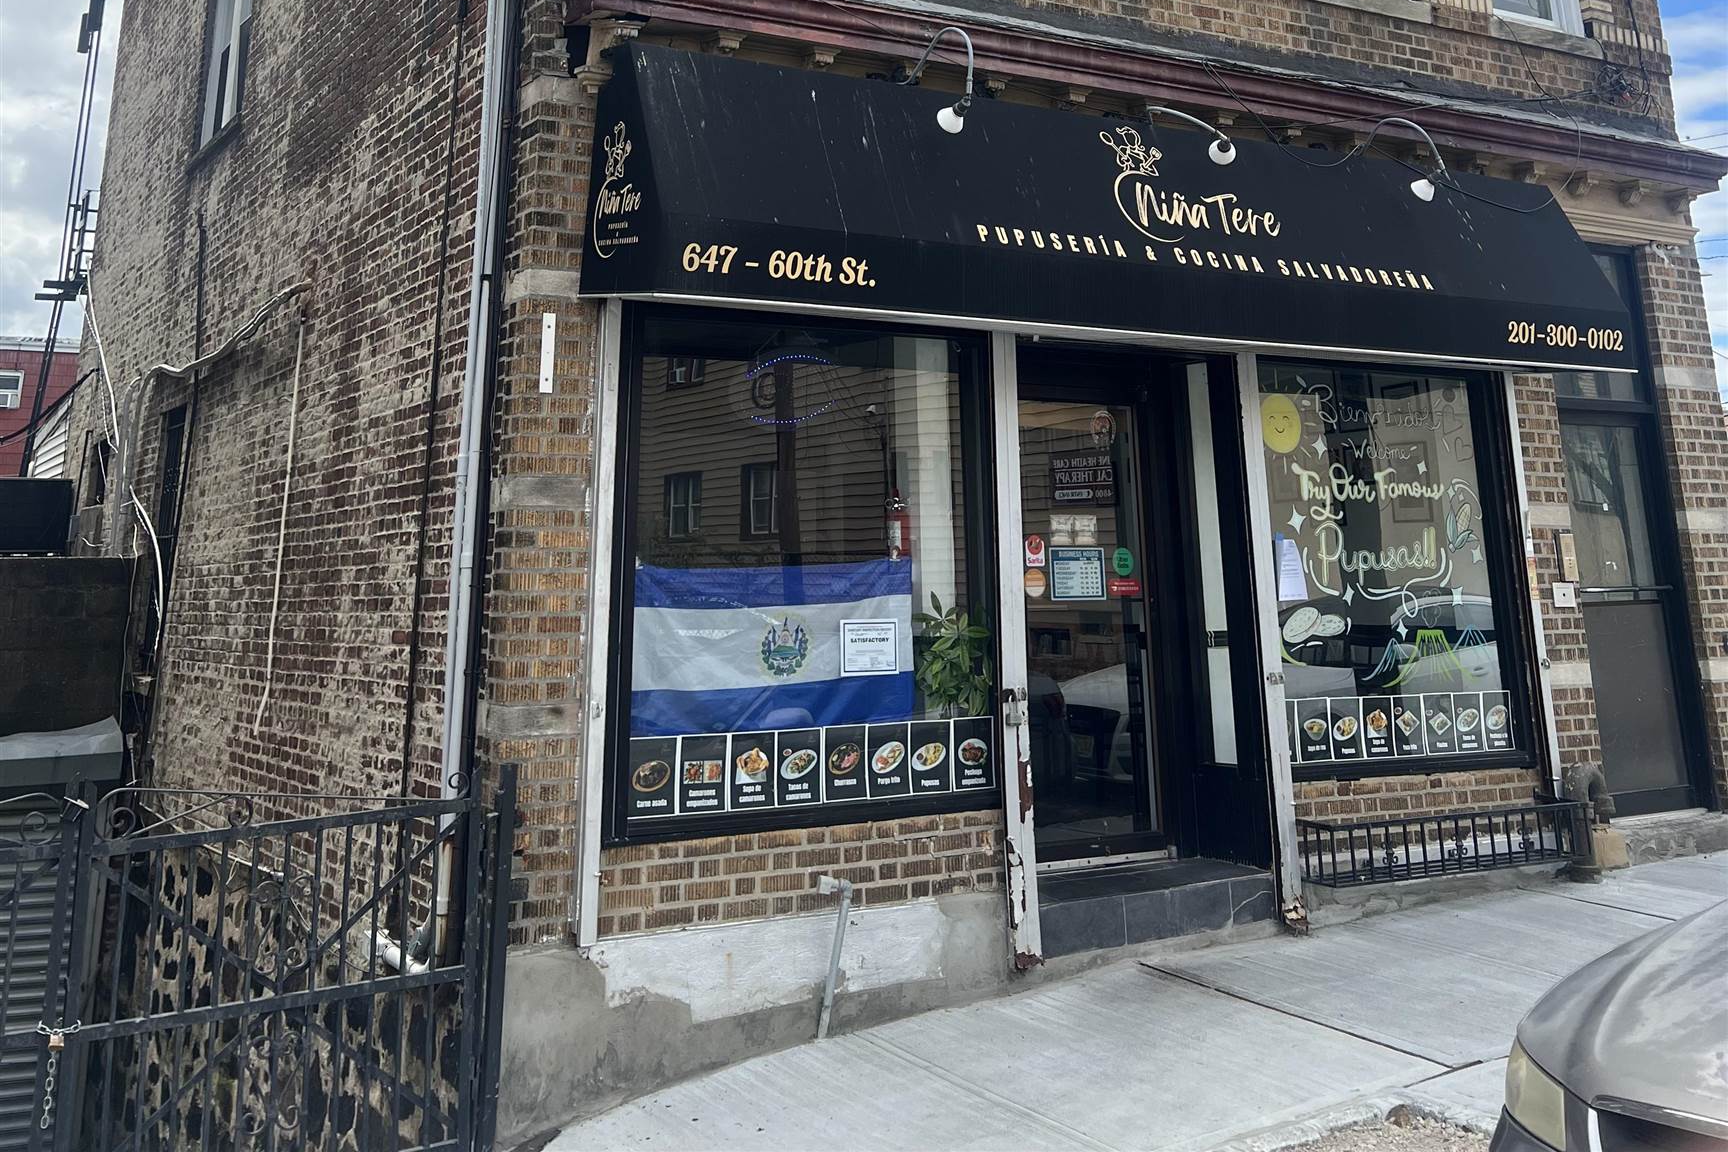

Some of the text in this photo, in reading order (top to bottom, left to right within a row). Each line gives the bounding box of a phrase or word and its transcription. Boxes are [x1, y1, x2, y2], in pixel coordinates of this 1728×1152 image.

[620, 183, 641, 215] Tere
[1134, 182, 1281, 238] Niña Tere
[682, 242, 738, 274] 647
[768, 250, 833, 283] 60th
[838, 256, 876, 288] St.
[976, 223, 1435, 291] PUPUSERÍA & COCINA SALVADOREÑA
[1508, 320, 1624, 351] 201-300-0102
[1348, 438, 1411, 460] Welcome
[1291, 462, 1444, 521] Try Our Famous
[1314, 521, 1437, 586] Pupusas!!
